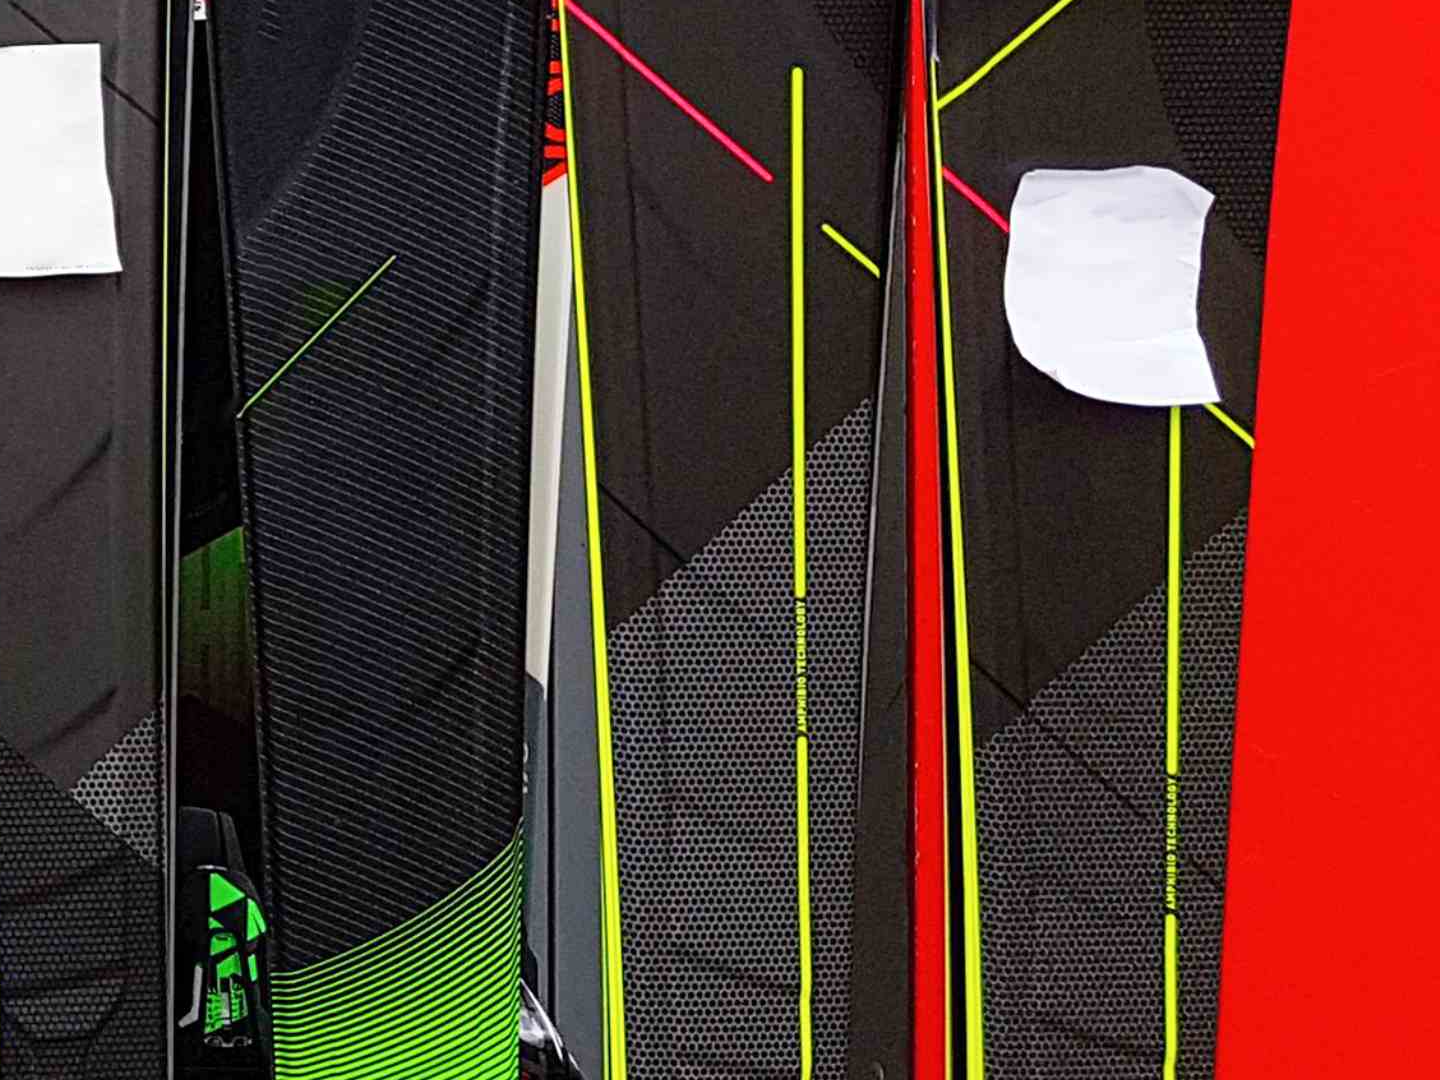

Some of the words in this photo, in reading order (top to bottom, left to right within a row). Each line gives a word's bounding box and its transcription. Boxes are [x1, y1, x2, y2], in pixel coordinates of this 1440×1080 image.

[796, 601, 807, 675] TECHNOLOGY
[796, 676, 807, 733] AMPHIBIO
[1166, 777, 1177, 852] TECHNOLOGY
[1166, 854, 1177, 910] AMPHIBIO
